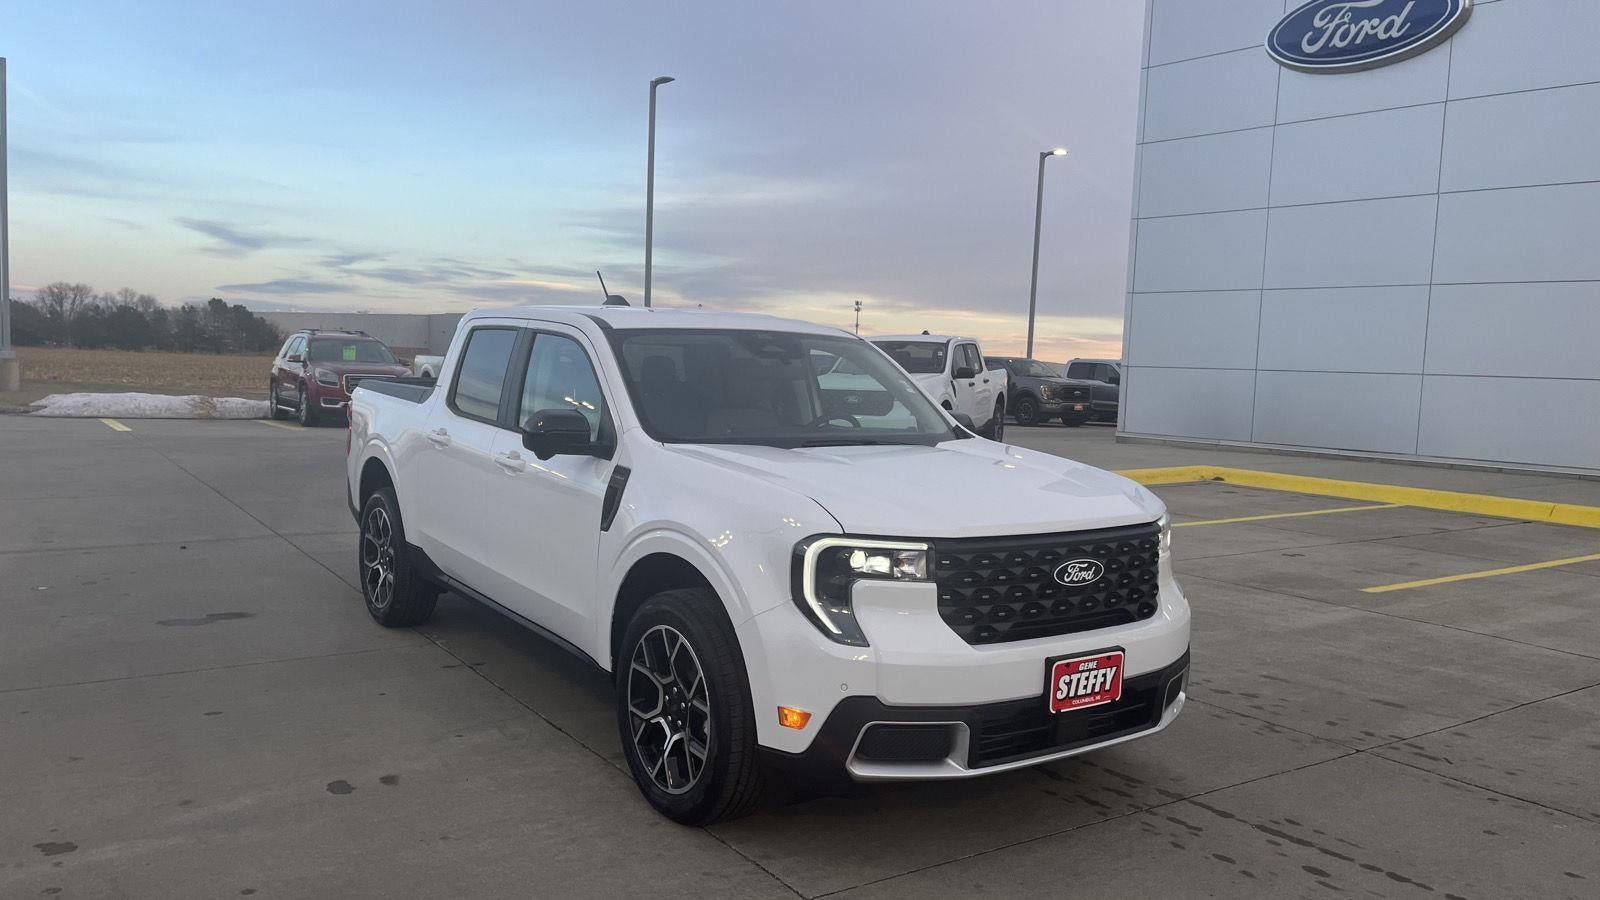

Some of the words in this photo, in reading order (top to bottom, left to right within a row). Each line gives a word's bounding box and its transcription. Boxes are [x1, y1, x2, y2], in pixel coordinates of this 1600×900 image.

[1301, 0, 1415, 53] Ford
[1064, 563, 1095, 582] Ford
[1079, 660, 1098, 671] GENE
[1056, 666, 1117, 700] STEFFY
